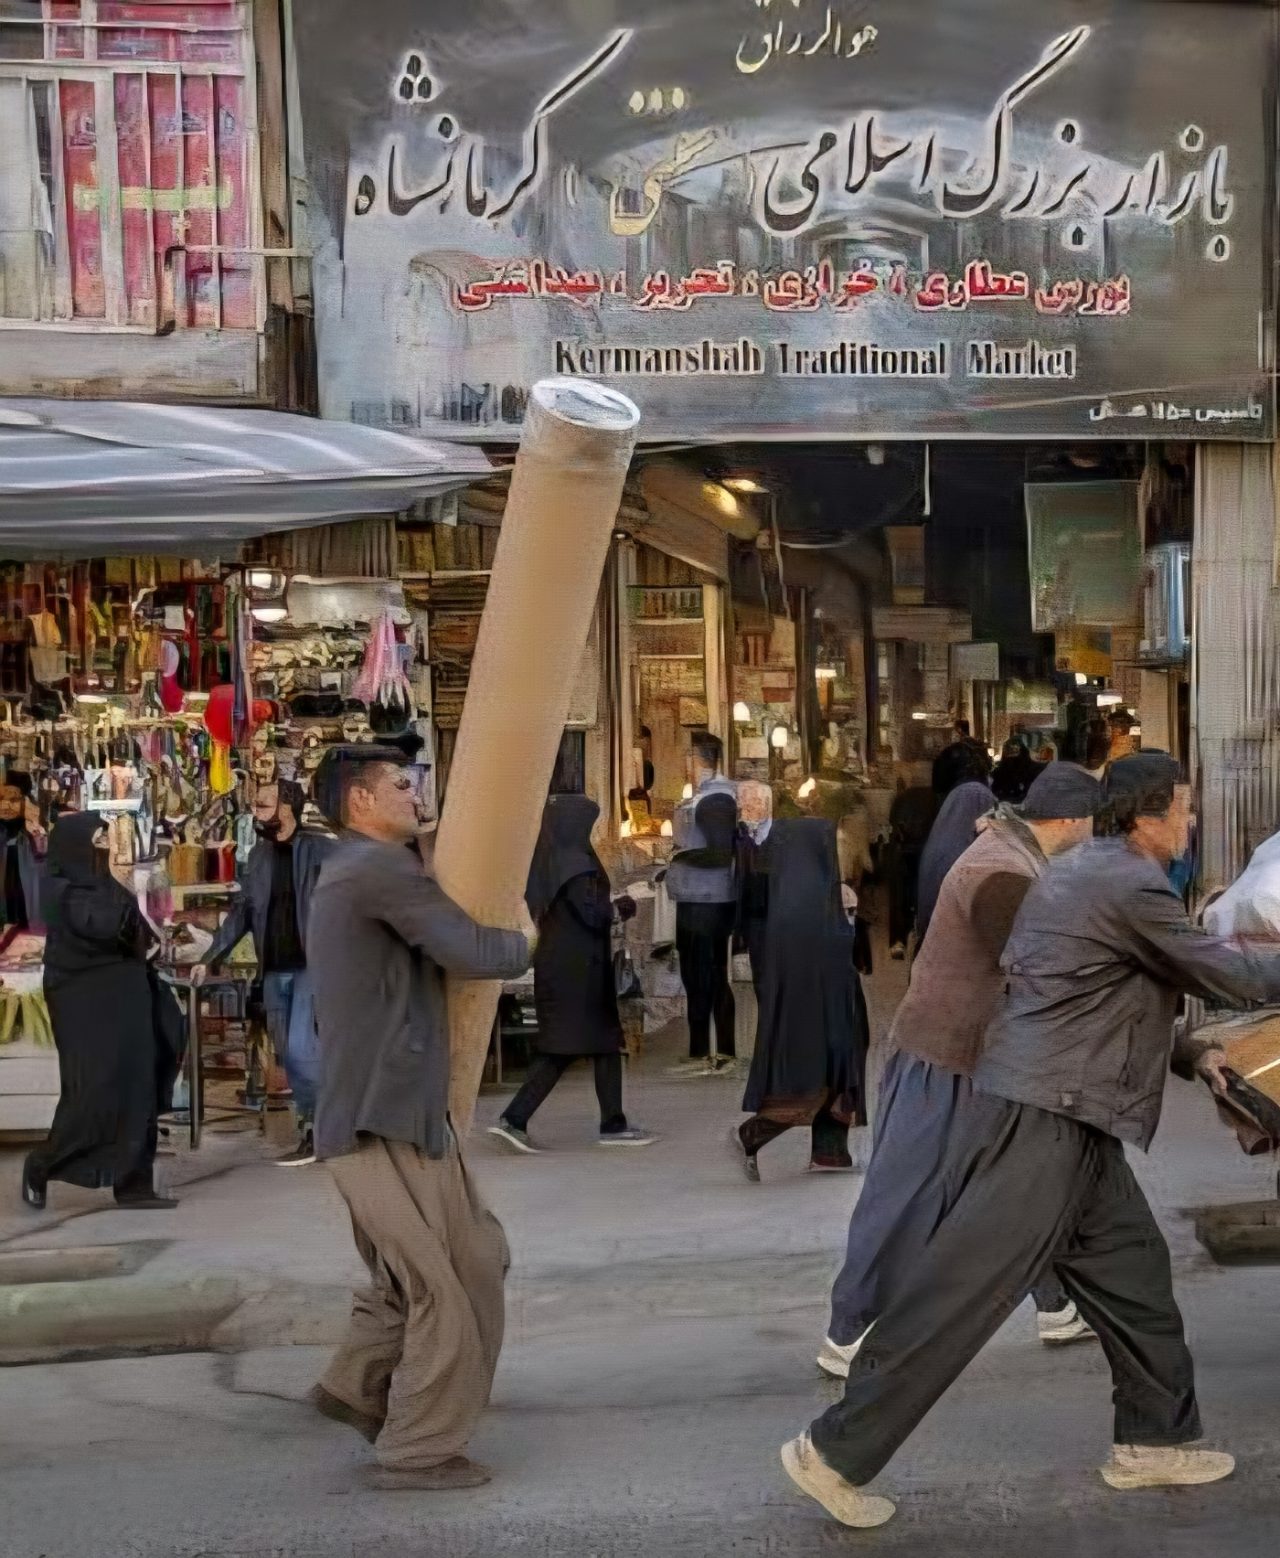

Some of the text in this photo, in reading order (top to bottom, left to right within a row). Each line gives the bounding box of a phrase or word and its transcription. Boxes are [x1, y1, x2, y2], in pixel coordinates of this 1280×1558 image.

[351, 27, 636, 222] کرمانشاه
[750, 110, 940, 238] اسلامی
[941, 24, 1097, 251] بزرگ
[1100, 122, 1236, 262] بازار
[555, 337, 767, 376] Kermanshah
[776, 339, 950, 378] Traditional
